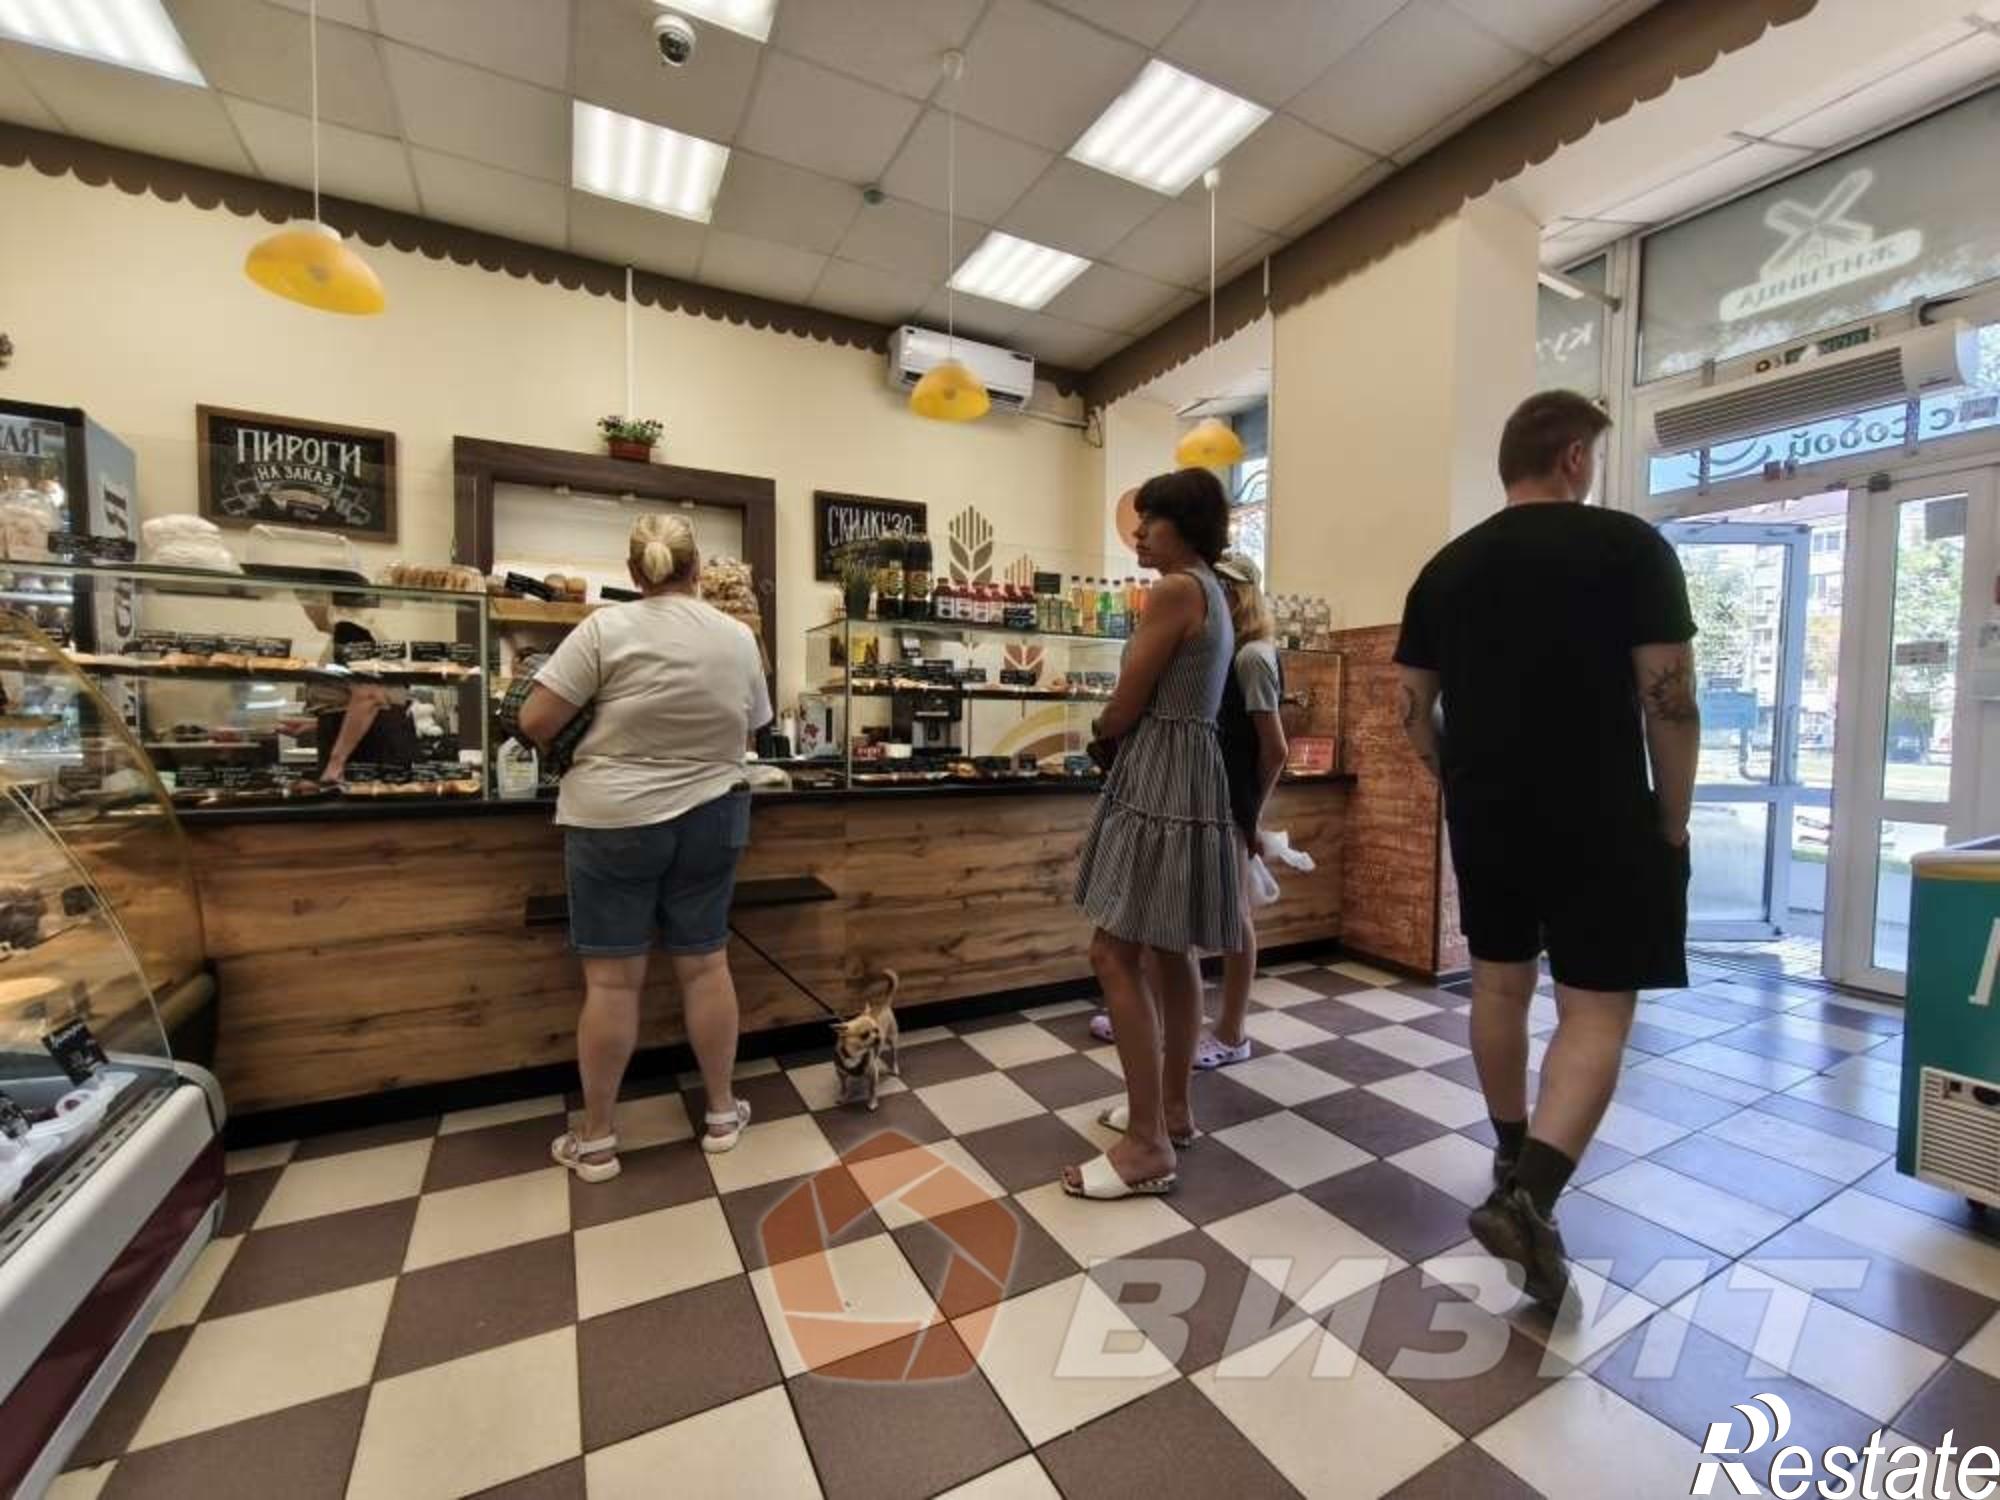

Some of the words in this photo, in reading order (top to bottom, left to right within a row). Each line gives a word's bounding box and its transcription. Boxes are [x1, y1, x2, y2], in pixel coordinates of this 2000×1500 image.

[0, 424, 40, 455] АЯ
[237, 428, 363, 478] ПИРОГИ
[257, 466, 281, 481] НА
[285, 466, 335, 487] ЗАКАЗ
